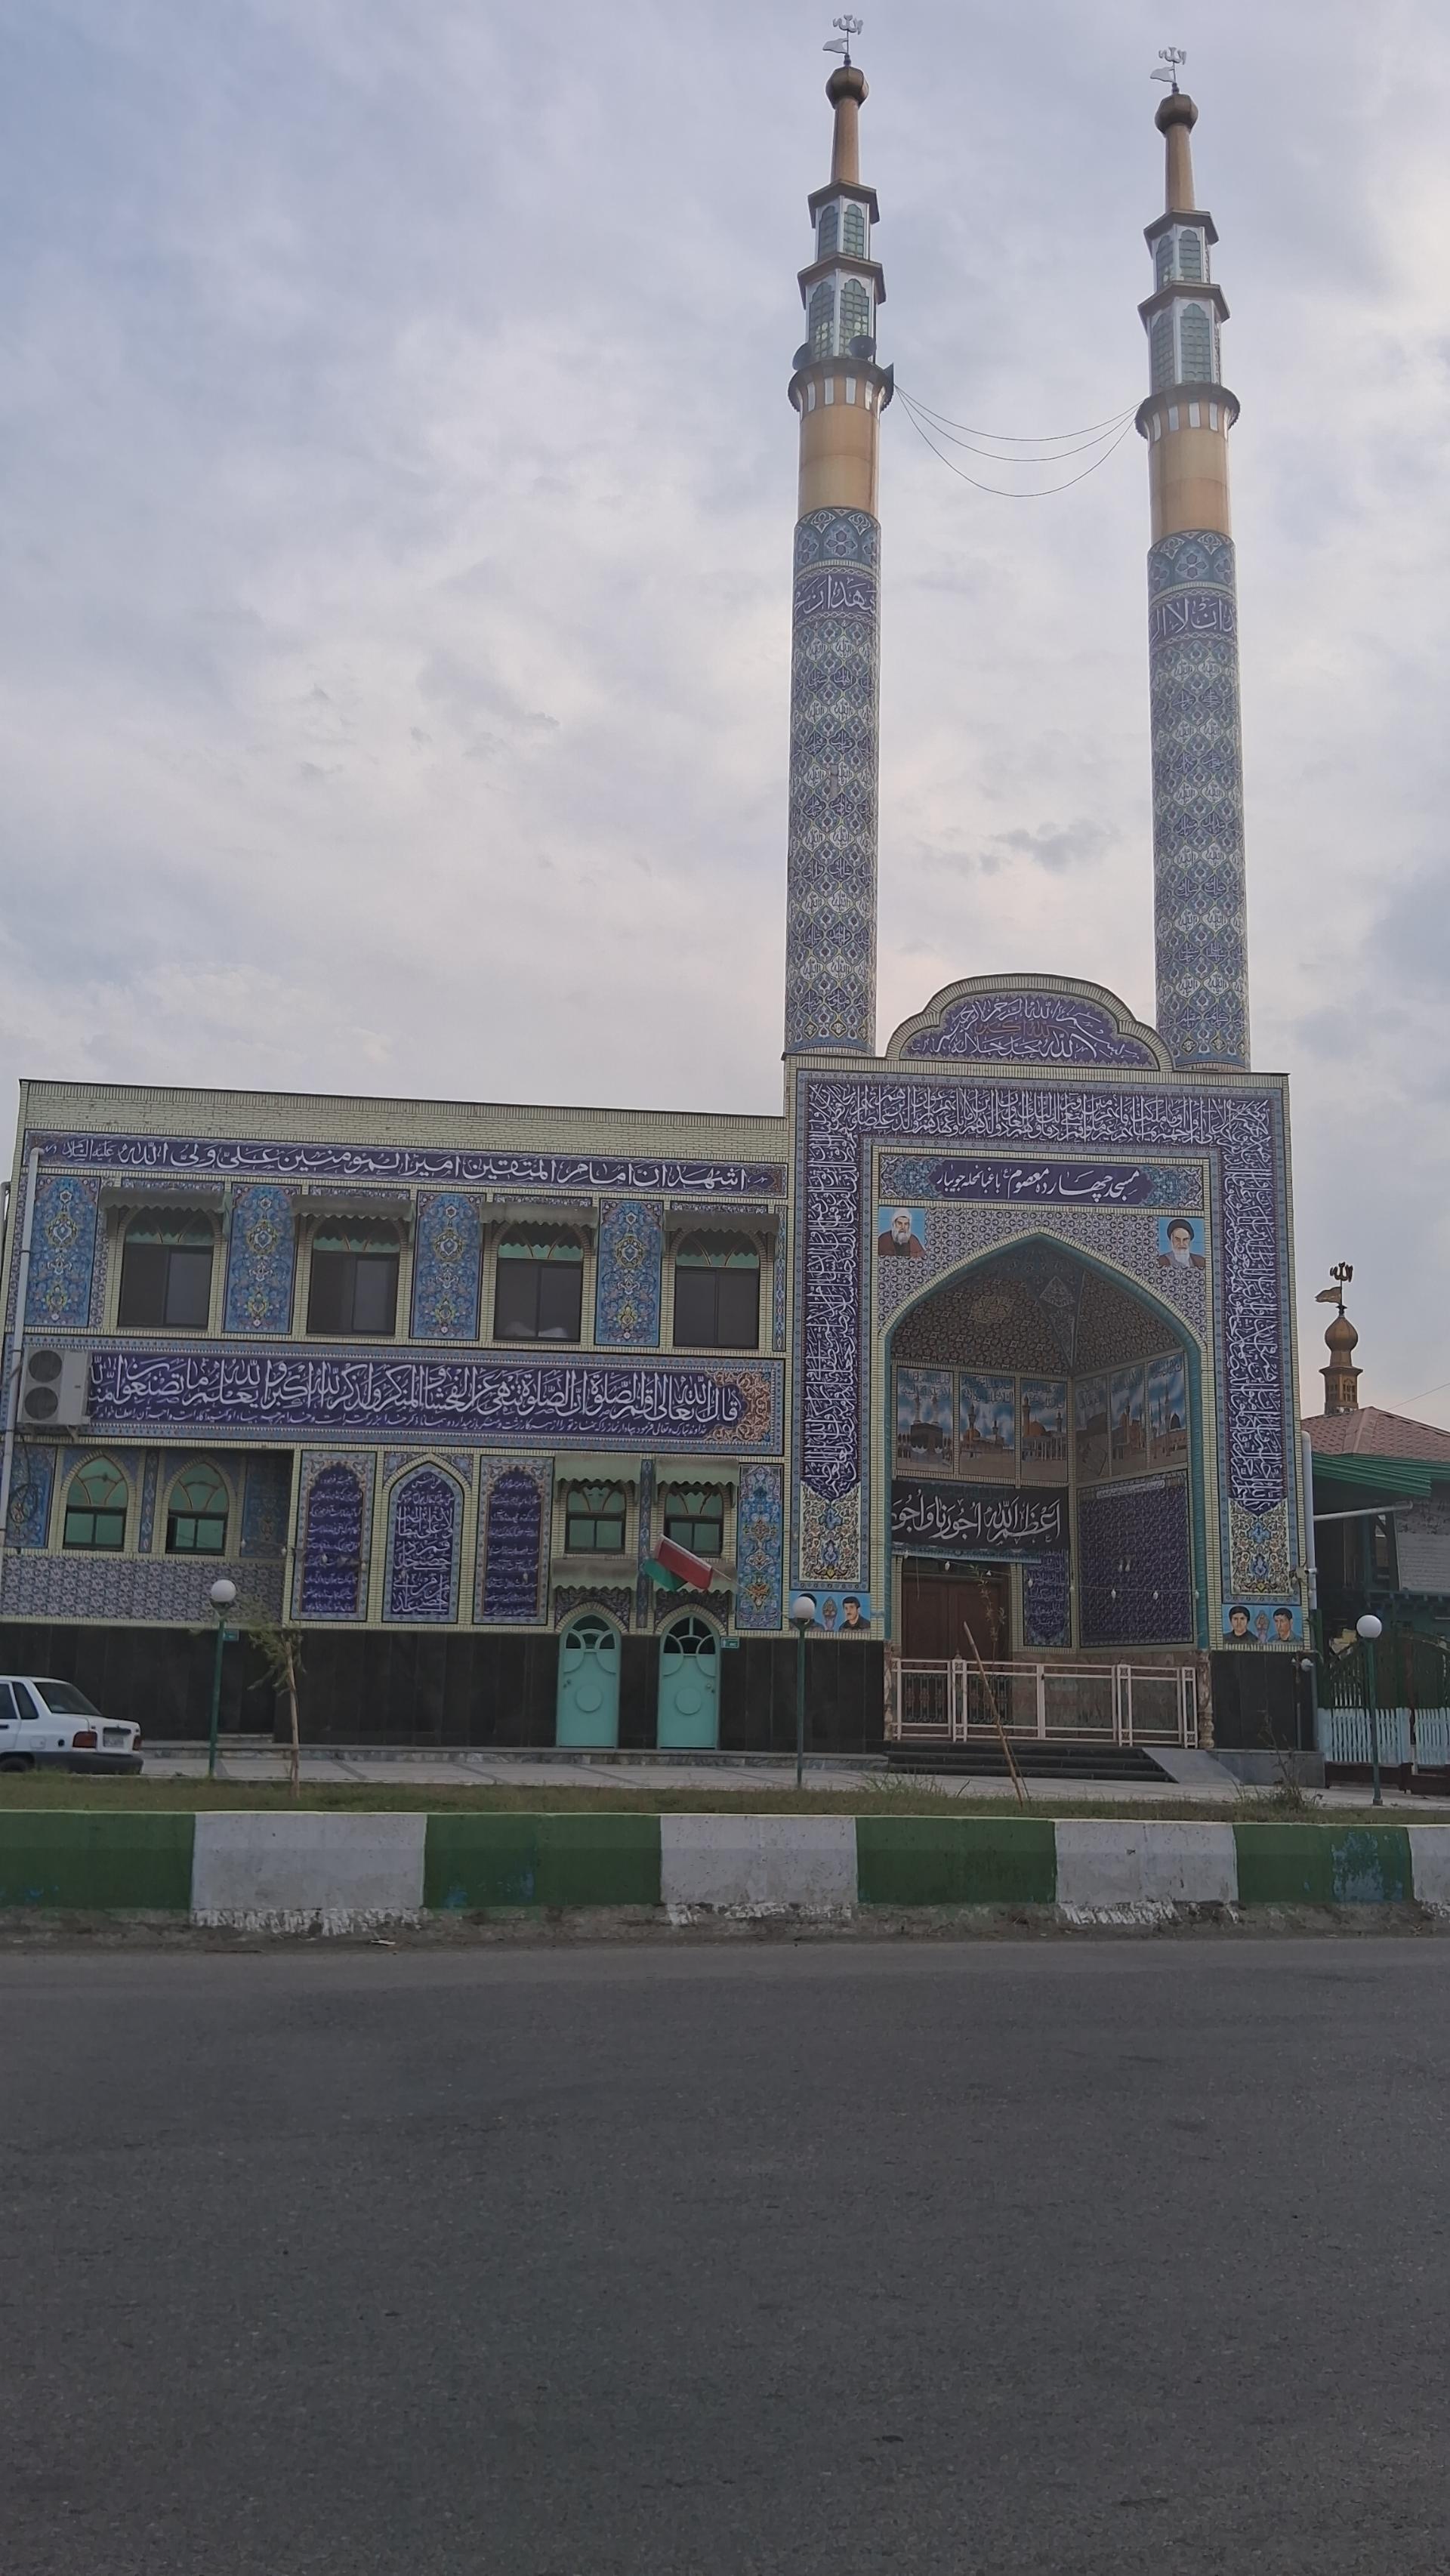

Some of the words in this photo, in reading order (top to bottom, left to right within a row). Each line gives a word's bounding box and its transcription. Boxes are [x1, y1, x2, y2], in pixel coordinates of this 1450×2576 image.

[1028, 1000, 1060, 1019] الله
[92, 1139, 118, 1161] علیه
[118, 1141, 168, 1165] الله
[171, 1143, 216, 1168] ولی
[218, 1144, 279, 1171] علی
[399, 1155, 459, 1177] امیر
[463, 1156, 555, 1183] المتقین
[557, 1162, 632, 1186] امام
[633, 1163, 666, 1188] ان
[668, 1164, 745, 1190] اشهد
[936, 1164, 965, 1192] جویبار
[1007, 1168, 1049, 1199] معصوم
[1035, 1170, 1113, 1202] چهارده
[1103, 1170, 1140, 1201] مسجد
[187, 1358, 209, 1390] ما
[310, 1361, 341, 1408] الله
[645, 1372, 694, 1421] تعالی
[674, 1376, 712, 1416] الله
[695, 1387, 739, 1423] قال
[287, 1411, 312, 1424] خدا
[385, 1414, 407, 1425] خدا
[406, 1413, 418, 1426] ذکر
[606, 1421, 620, 1433] نماز
[637, 1423, 653, 1435] فرمود
[929, 1496, 982, 1541] اجورنا
[983, 1497, 1019, 1529] الله
[986, 1498, 1060, 1544] اعظم
